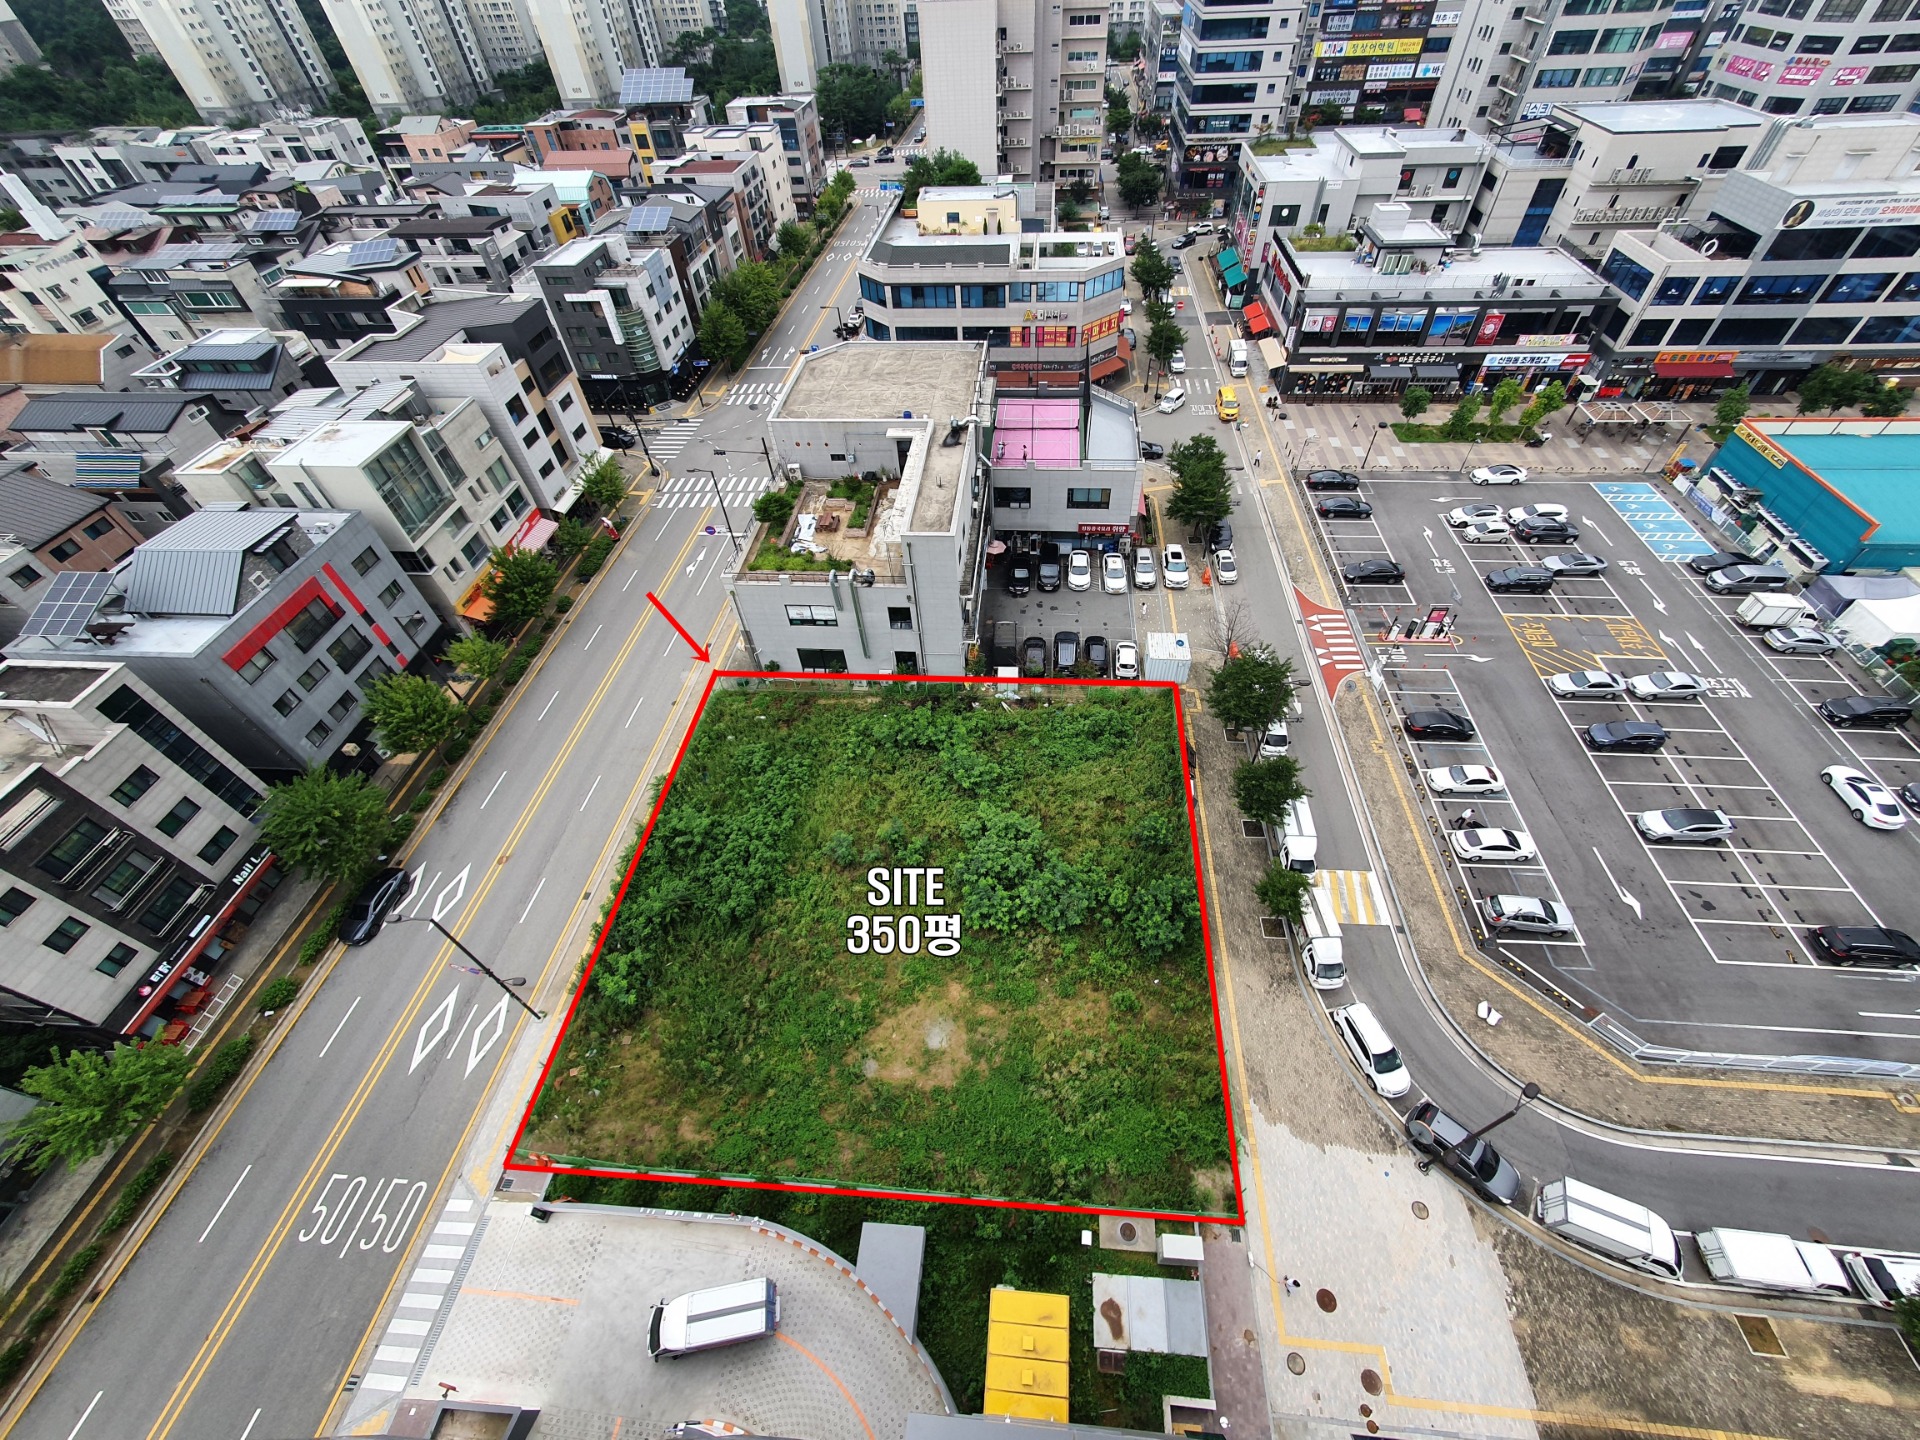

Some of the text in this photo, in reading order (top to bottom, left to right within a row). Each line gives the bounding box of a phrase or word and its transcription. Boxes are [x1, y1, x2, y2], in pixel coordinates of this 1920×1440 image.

[1352, 42, 1395, 54] 정상어학원
[1092, 317, 1118, 336] 마사지
[1398, 355, 1445, 364] 마포소금구이
[1520, 356, 1551, 364] 조개창고
[232, 861, 254, 885] Nail
[298, 1173, 428, 1253] 50 50
